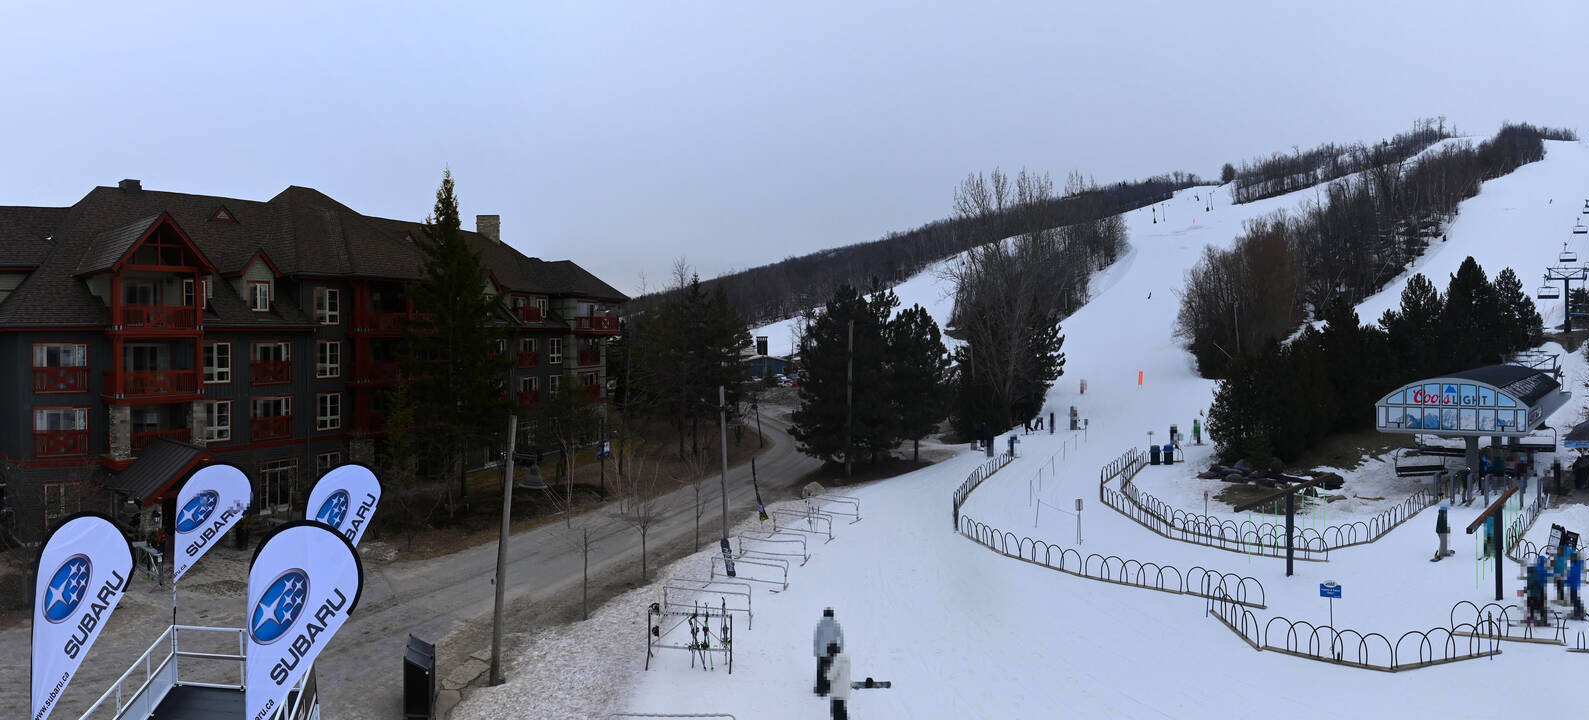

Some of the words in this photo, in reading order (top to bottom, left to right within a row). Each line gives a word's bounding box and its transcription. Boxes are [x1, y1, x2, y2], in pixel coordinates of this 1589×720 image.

[1452, 394, 1488, 405] LIGHT
[345, 493, 376, 542] BARU
[64, 570, 124, 660] SUBARU
[270, 588, 347, 686] SUBARU
